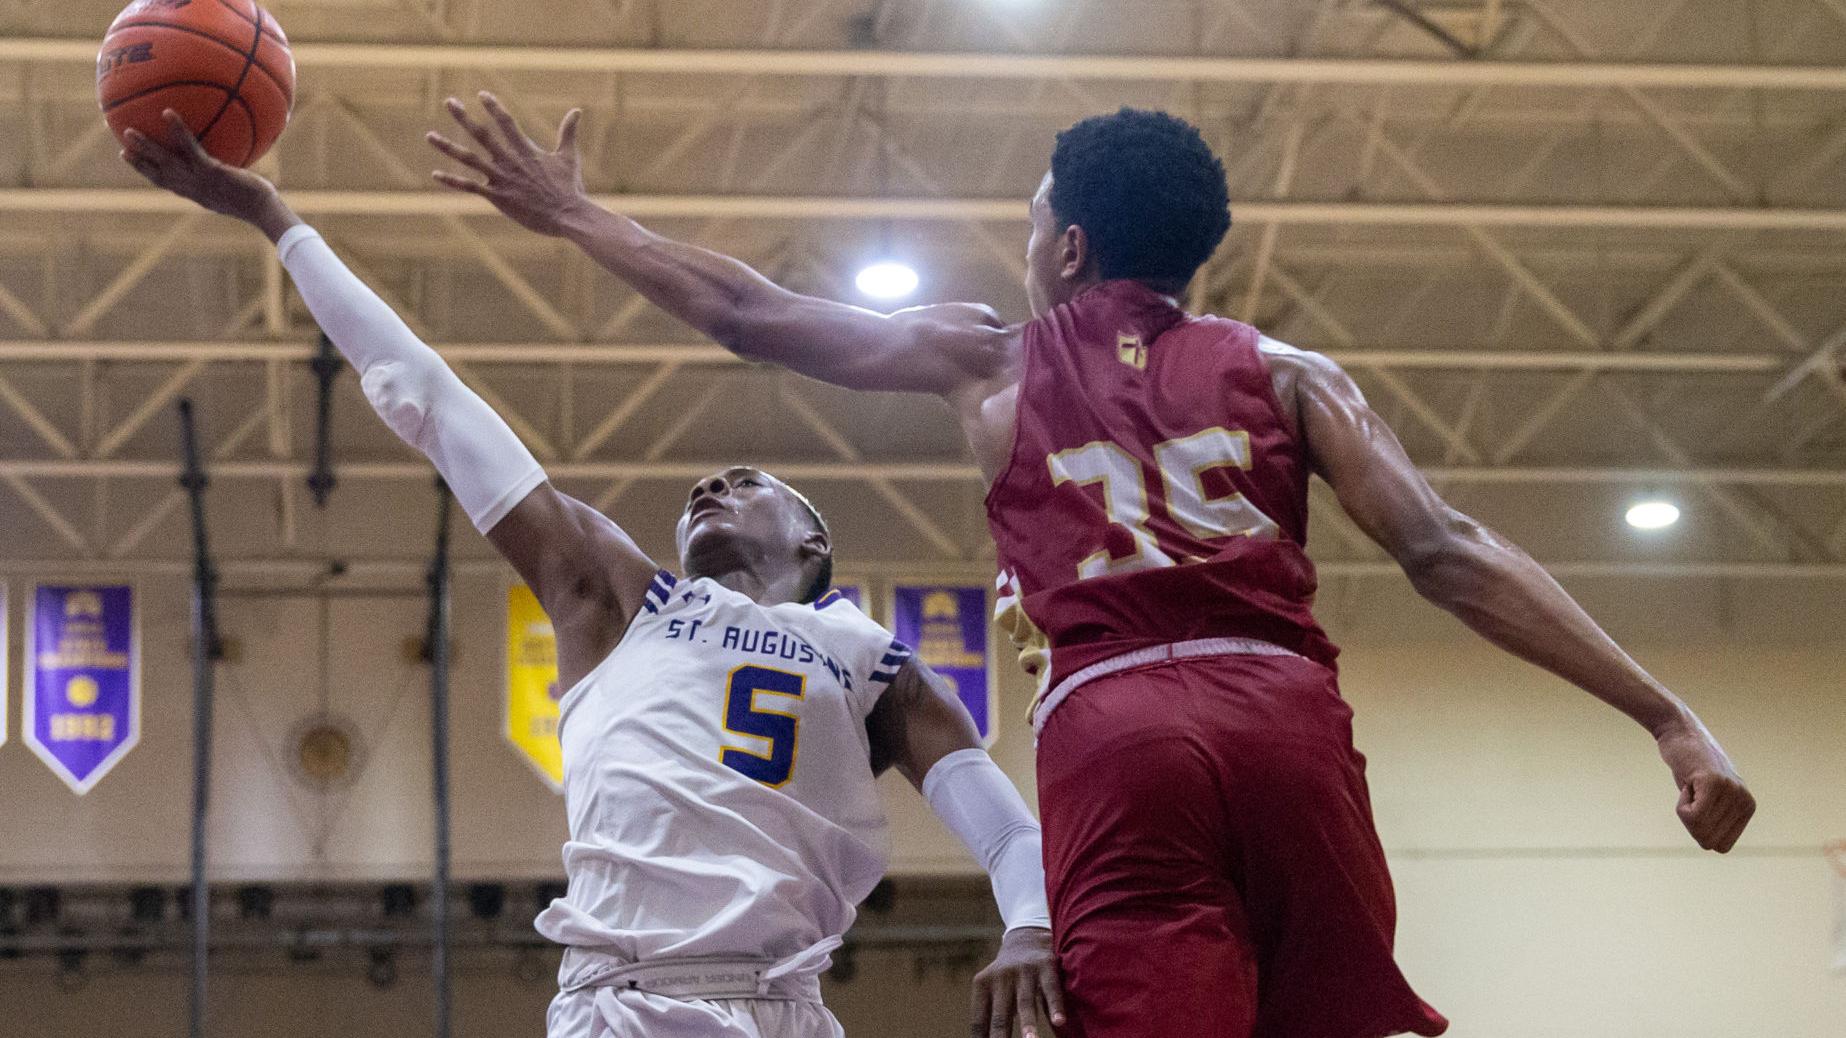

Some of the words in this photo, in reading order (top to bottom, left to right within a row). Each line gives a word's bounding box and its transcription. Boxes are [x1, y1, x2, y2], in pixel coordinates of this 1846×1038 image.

[1047, 426, 1280, 580] 35
[665, 620, 707, 643] ST.
[719, 660, 808, 790] 5
